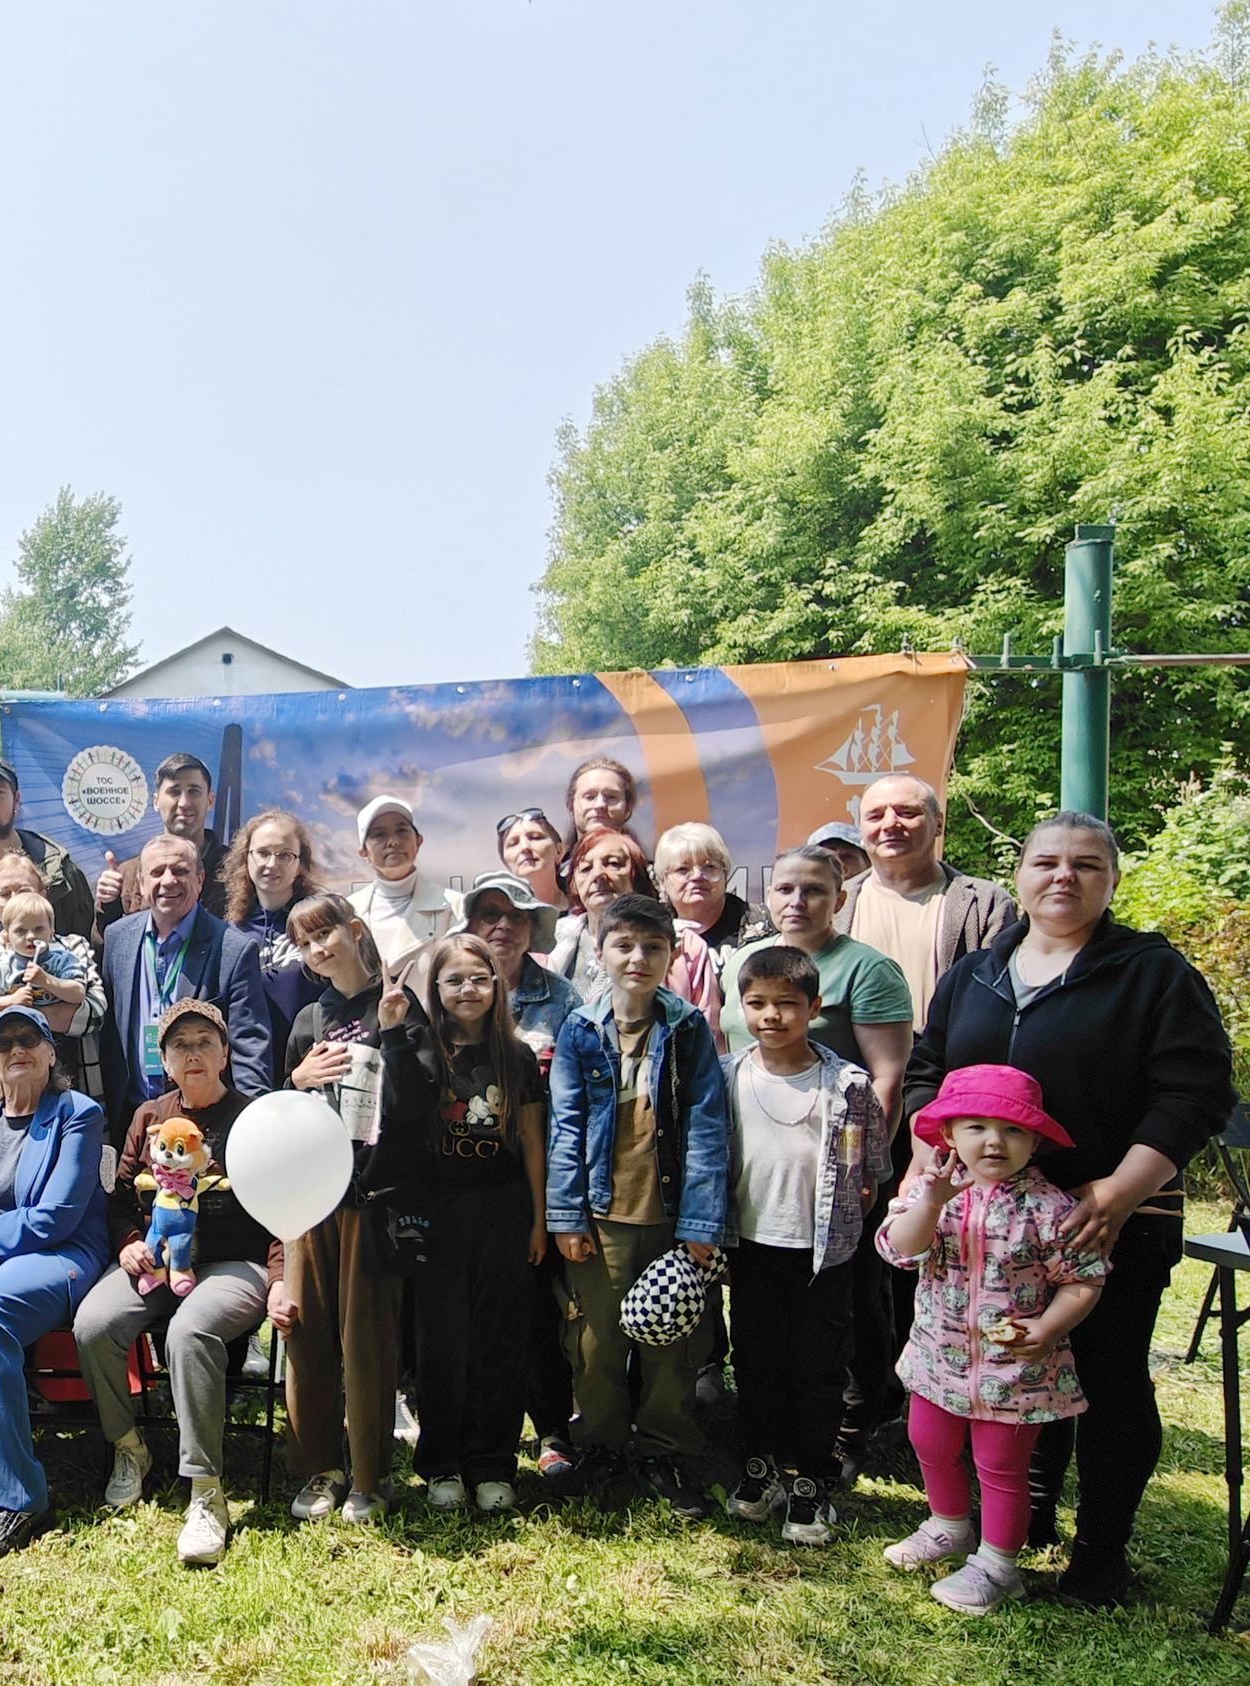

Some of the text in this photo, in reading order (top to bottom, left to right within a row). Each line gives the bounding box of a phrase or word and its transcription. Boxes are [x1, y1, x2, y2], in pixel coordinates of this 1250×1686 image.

[96, 776, 114, 785] ТОС
[82, 786, 130, 795] «ВОЕННОЕ
[86, 796, 126, 805] ШОССЕ»
